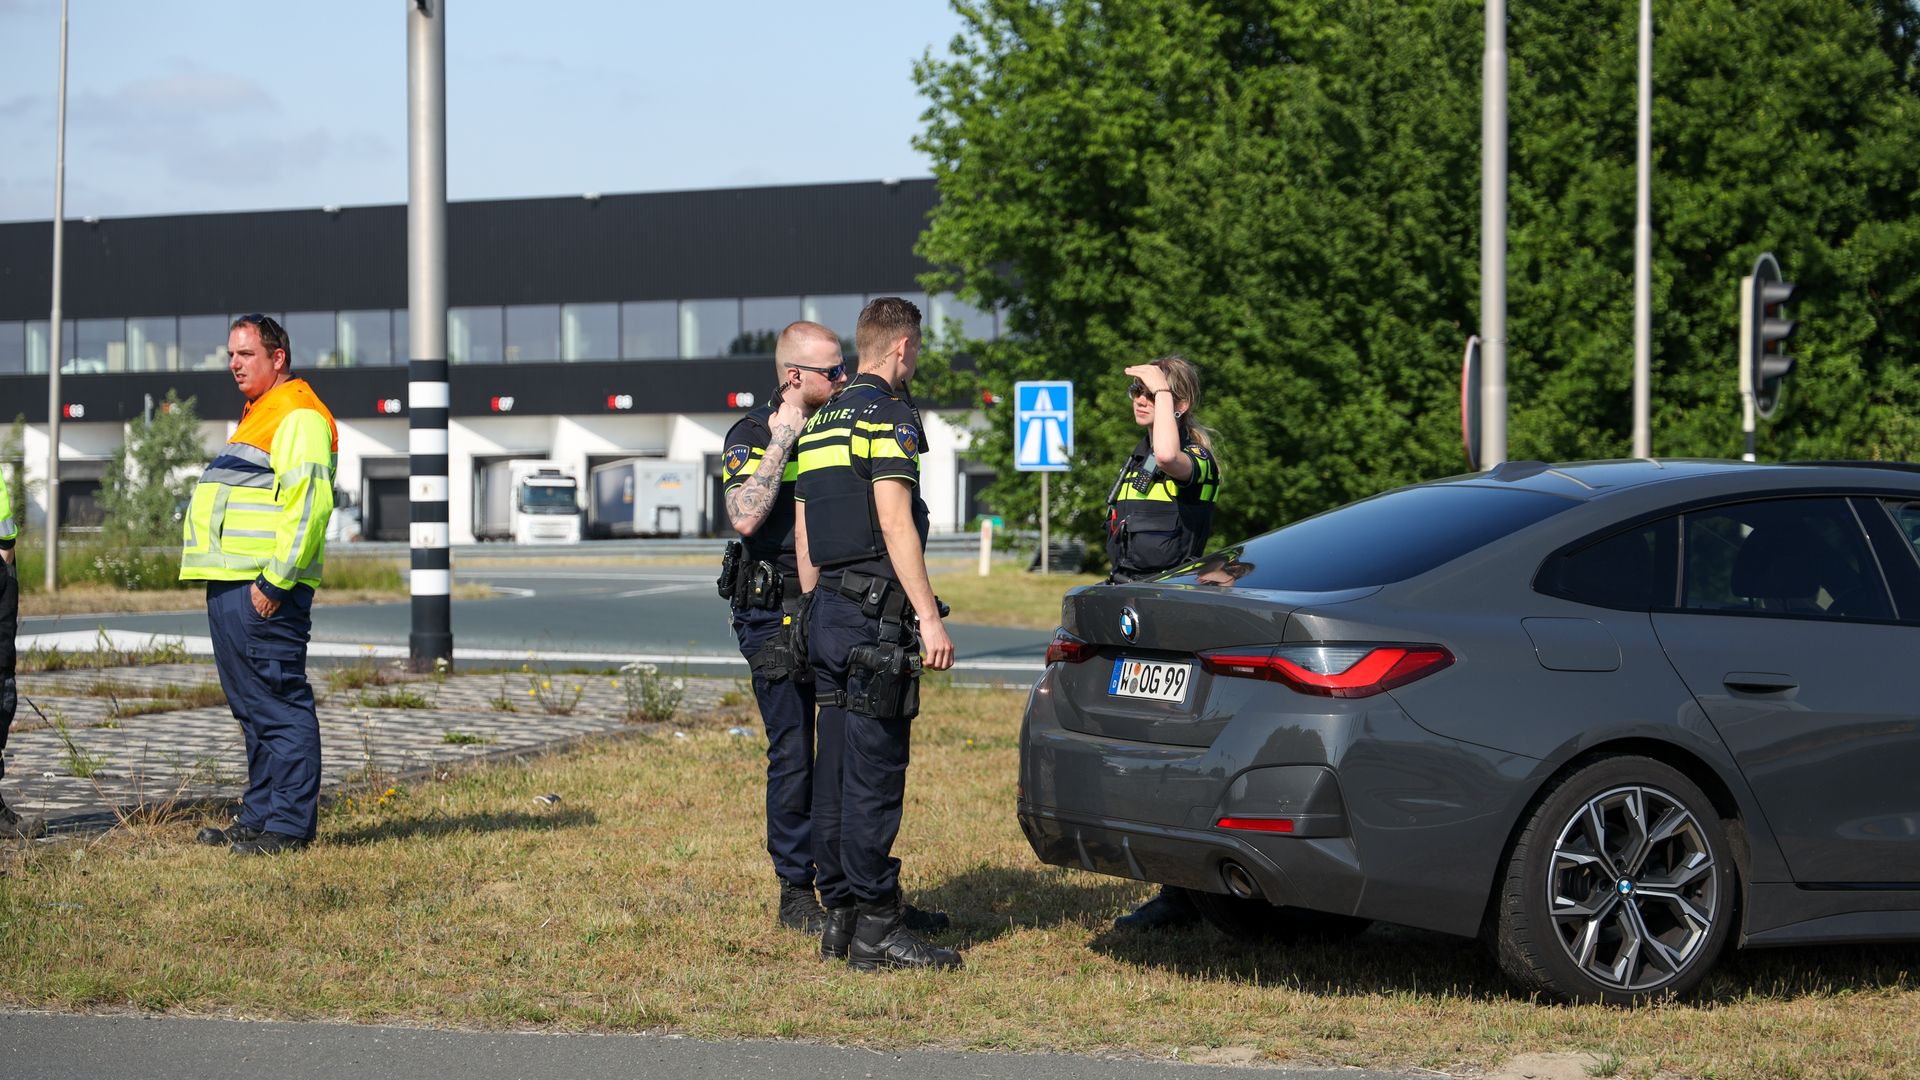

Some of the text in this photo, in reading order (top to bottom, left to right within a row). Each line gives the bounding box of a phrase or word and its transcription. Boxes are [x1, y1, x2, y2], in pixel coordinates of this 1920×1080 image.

[804, 408, 850, 433] POLITIE
[1120, 662, 1186, 697] W OG 99
